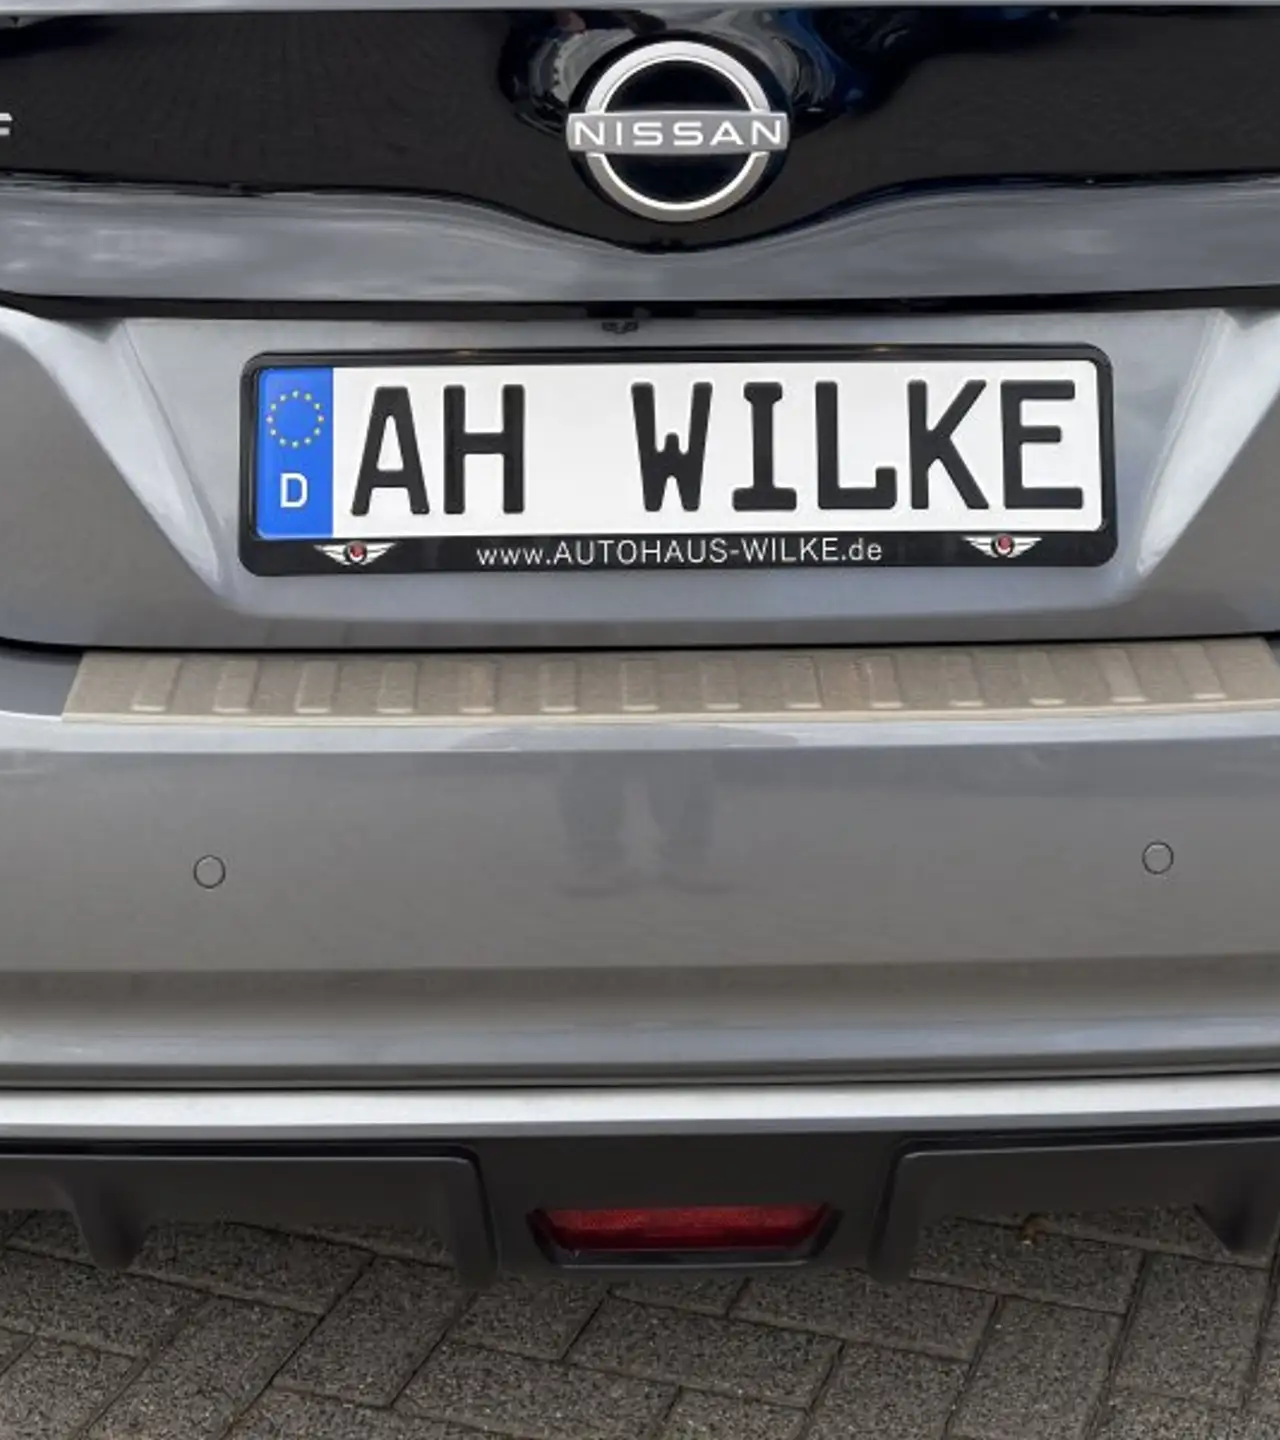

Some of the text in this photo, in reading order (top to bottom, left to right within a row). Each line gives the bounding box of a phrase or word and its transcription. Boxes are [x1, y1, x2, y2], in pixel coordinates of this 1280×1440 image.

[574, 121, 782, 147] NISSAN
[349, 379, 1085, 516] AH WILKE
[280, 473, 308, 508] D
[476, 536, 884, 566] www.AUTOHAUS-WILKE.de
